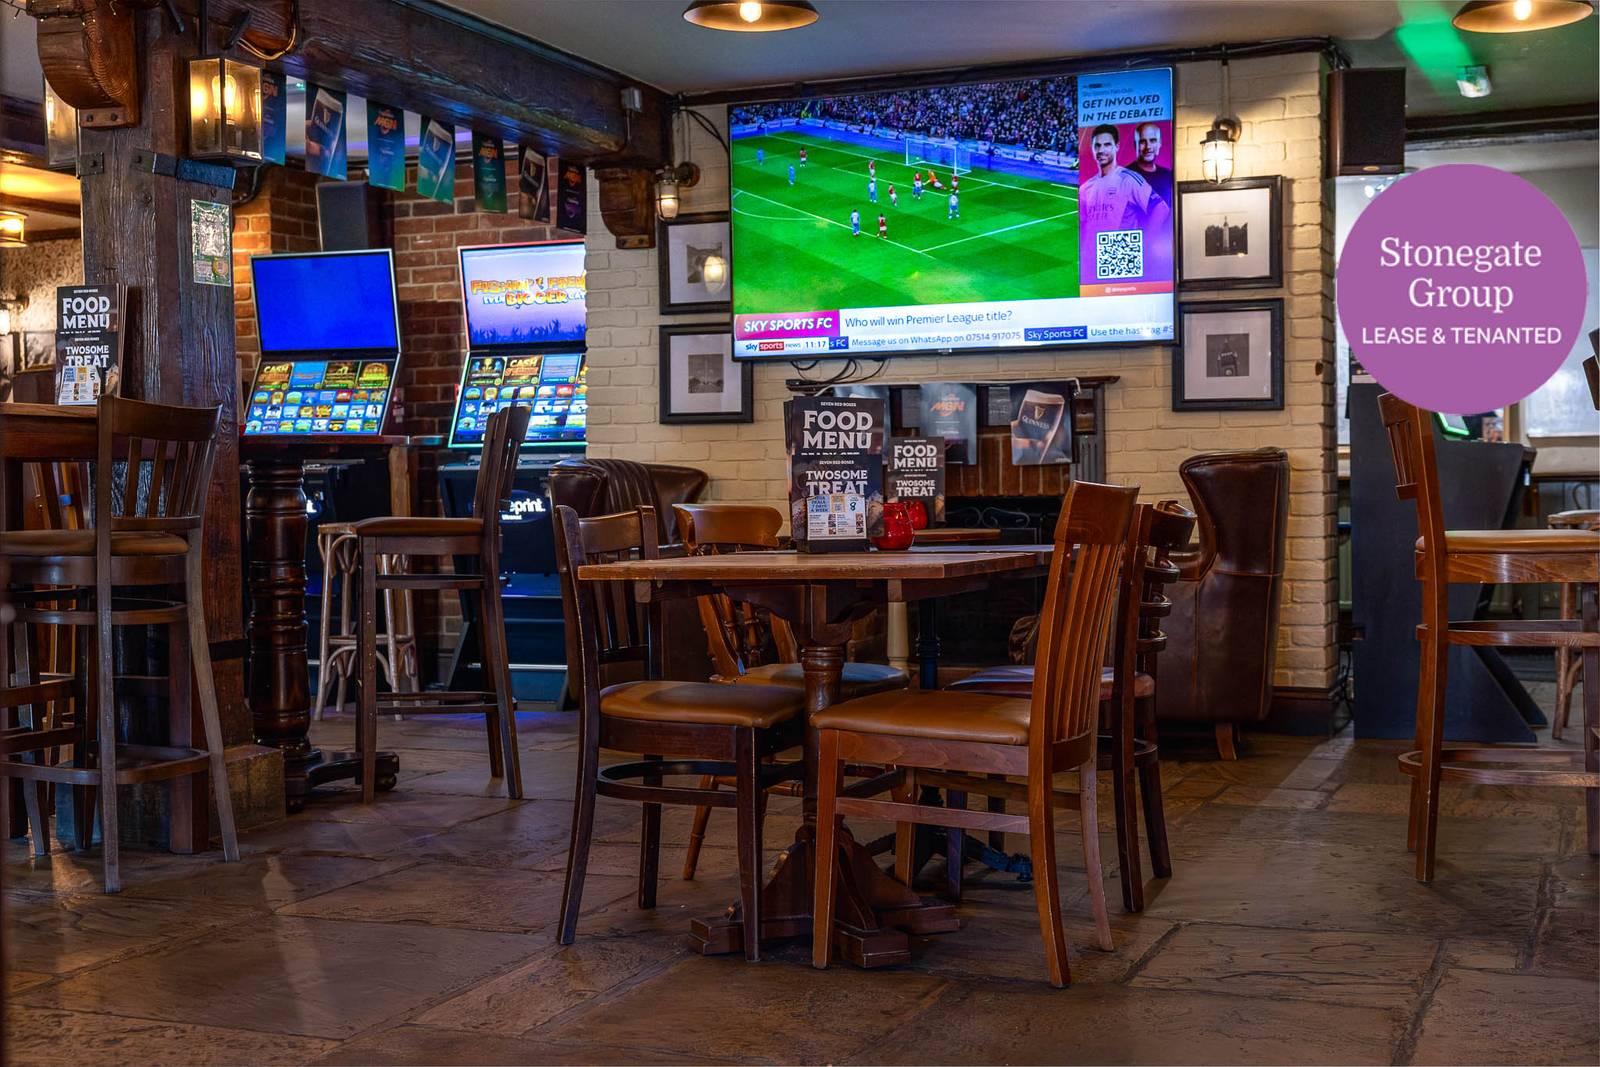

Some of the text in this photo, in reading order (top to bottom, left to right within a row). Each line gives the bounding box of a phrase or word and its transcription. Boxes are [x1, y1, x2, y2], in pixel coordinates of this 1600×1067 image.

[1082, 94, 1160, 109] GET INVOLVED
[1082, 107, 1164, 122] IN THE DEBATE!
[62, 297, 110, 314] FOOD
[63, 313, 110, 329] MENU
[744, 318, 833, 332] SKY SPORTS FC
[845, 310, 1013, 327] Who will win Premier League title?
[835, 338, 847, 346] FC
[851, 338, 886, 348] Message
[887, 337, 898, 345] us
[910, 335, 952, 345] WhatsApp
[965, 333, 990, 342] 07514
[991, 331, 1021, 341] 917075
[1027, 331, 1042, 341] Sky
[1043, 330, 1072, 340] Sports
[1073, 328, 1085, 337] FC
[1090, 328, 1107, 336] Use
[1108, 328, 1124, 336] the
[65, 346, 109, 355] TWOSOME
[745, 343, 758, 351] sky
[759, 342, 784, 351] sports
[805, 341, 827, 349] 11:17
[65, 355, 109, 368] TREAT
[510, 358, 538, 367] CASH
[264, 364, 289, 374] CASH
[803, 410, 873, 430] FOOD
[1022, 415, 1050, 430] GUINNESS
[802, 430, 873, 449] MENU
[894, 445, 937, 457] FOOD
[894, 457, 937, 469] MENU
[805, 470, 868, 480] TWOSOME
[805, 480, 868, 496] TREAT
[896, 487, 936, 497] TREAT
